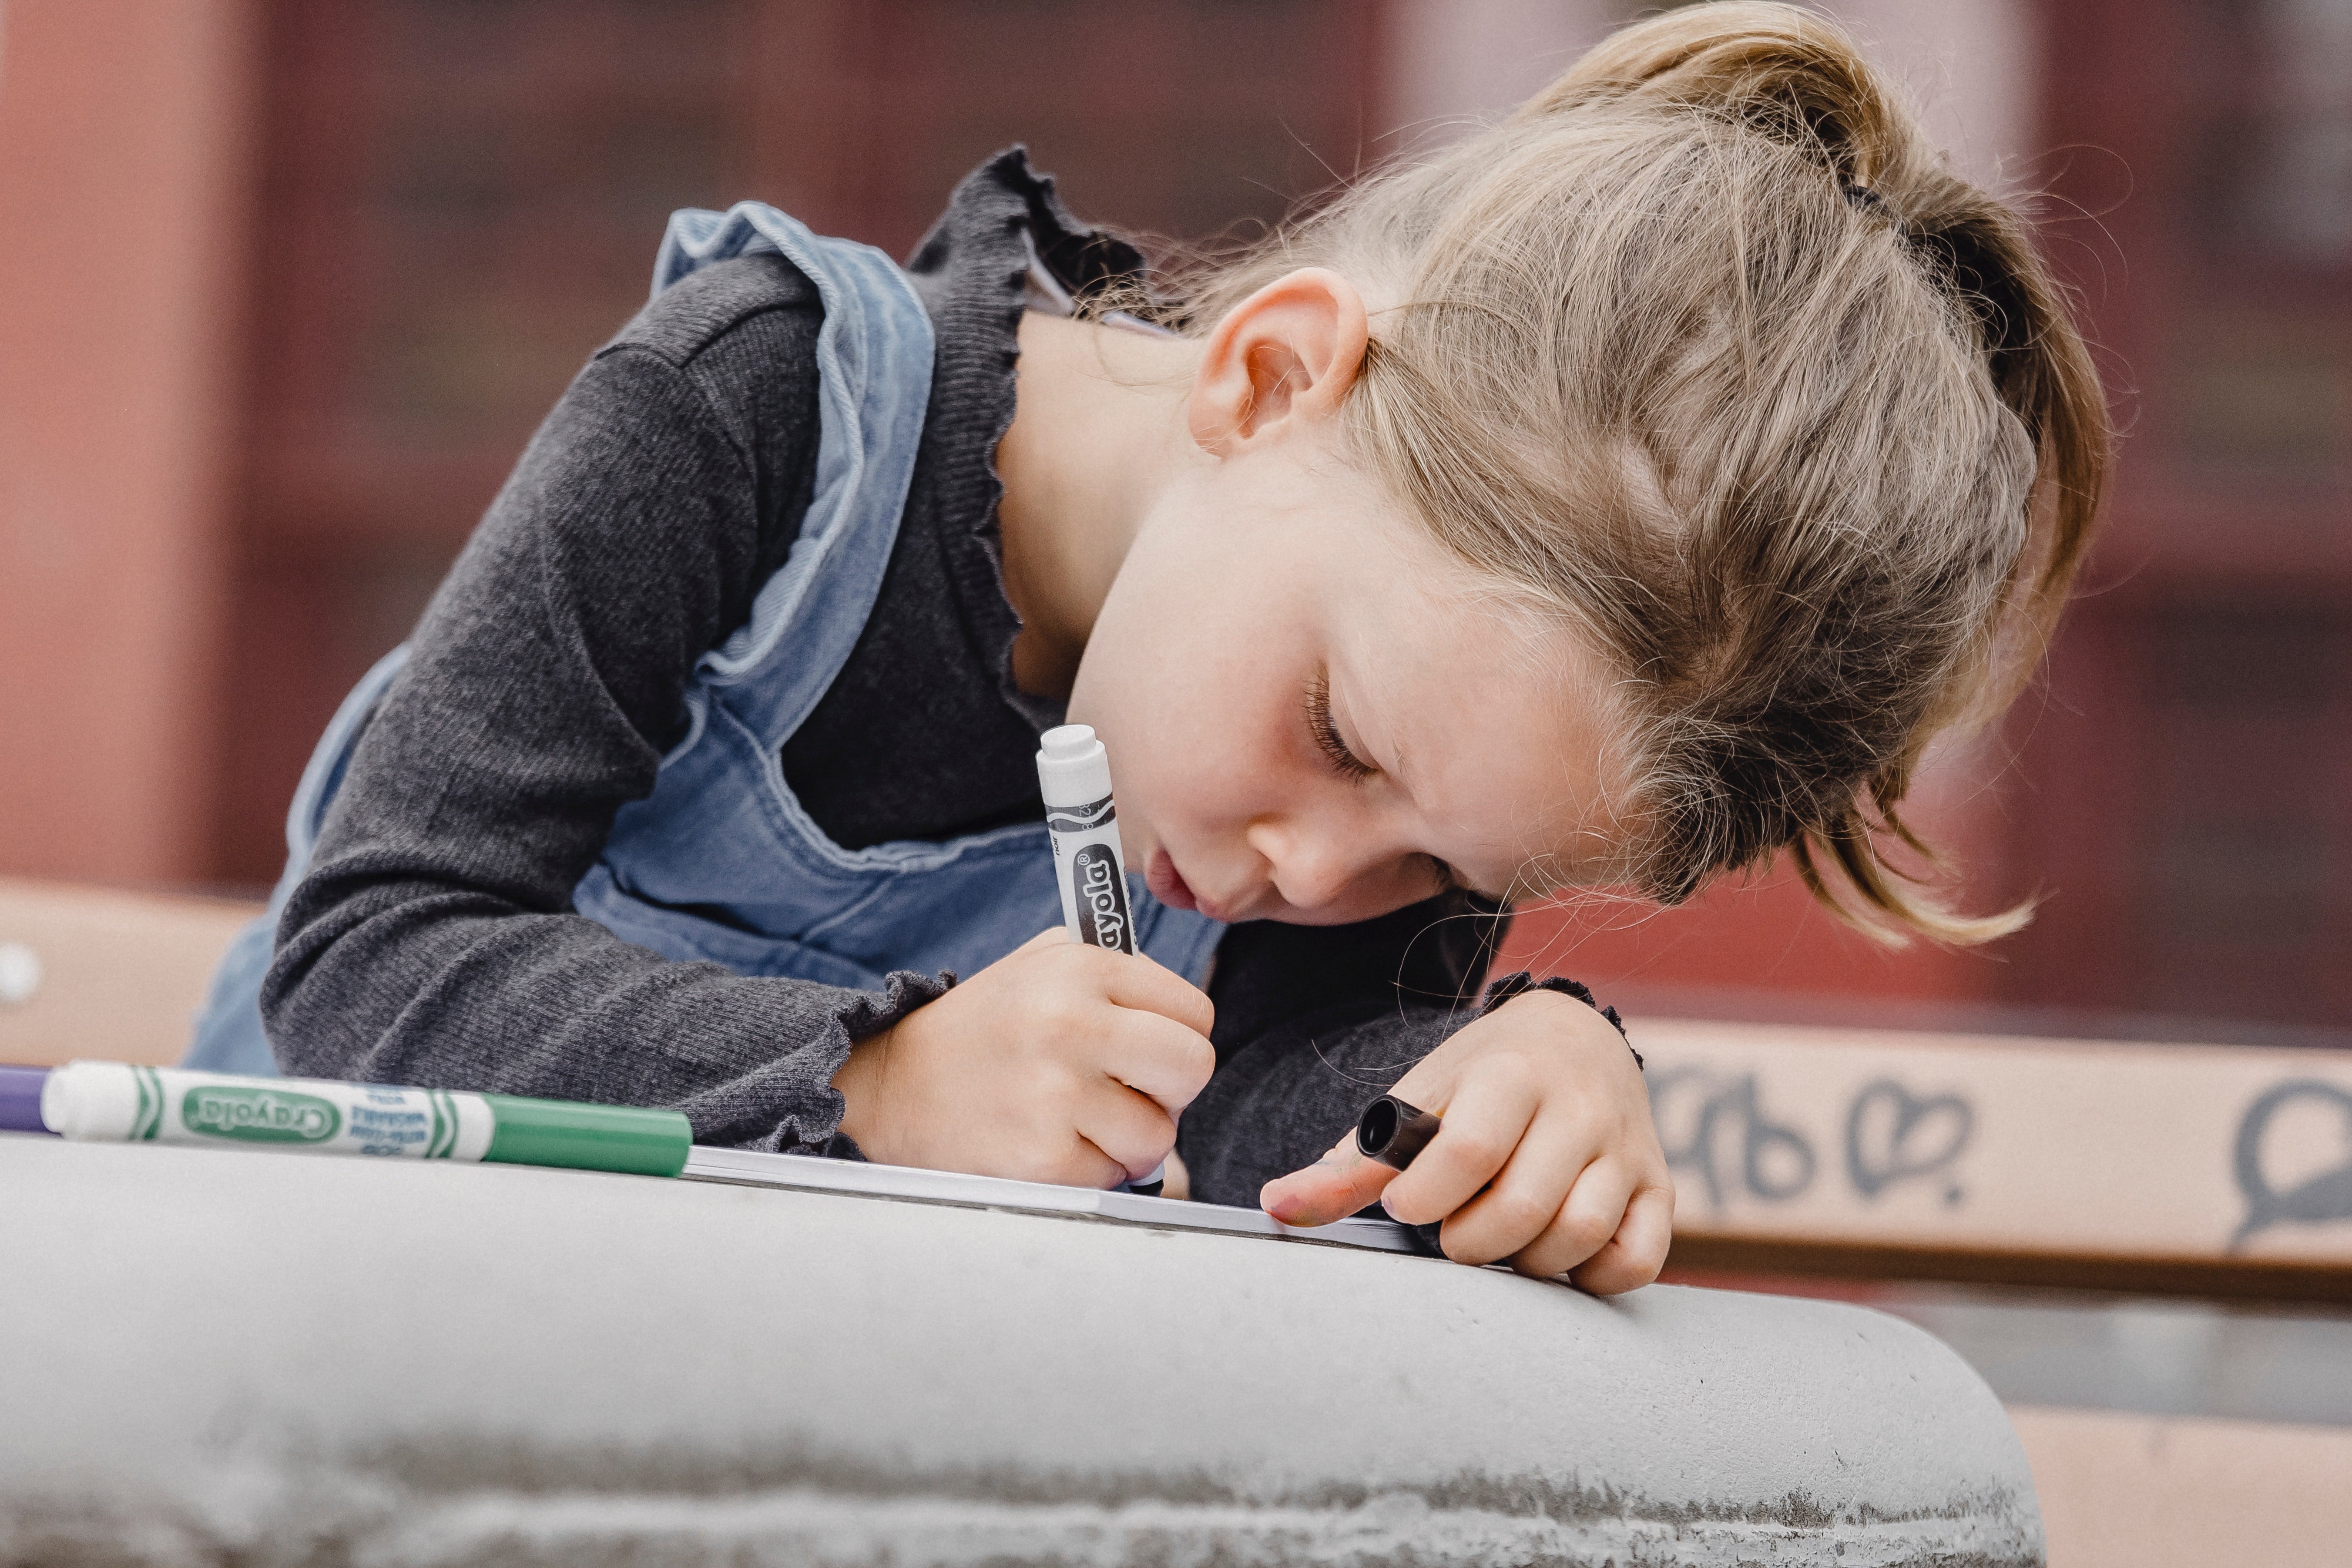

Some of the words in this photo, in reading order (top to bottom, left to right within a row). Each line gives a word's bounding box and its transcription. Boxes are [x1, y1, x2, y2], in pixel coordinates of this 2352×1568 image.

[1052, 836, 1060, 856] noir
[1083, 860, 1124, 951] ayola
[200, 1095, 331, 1138] Crayola
